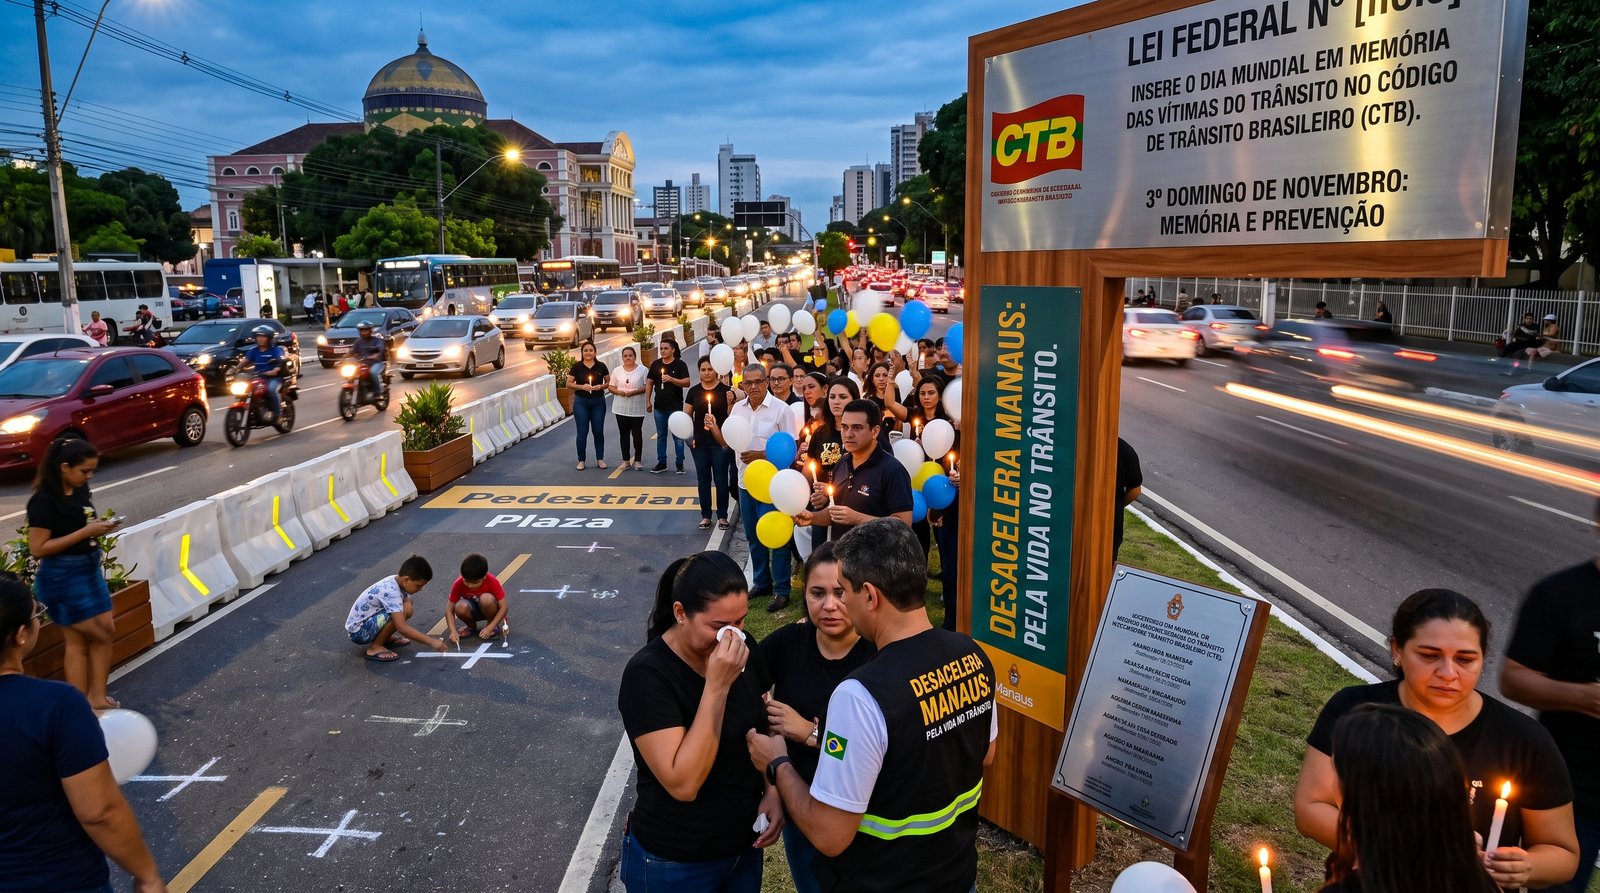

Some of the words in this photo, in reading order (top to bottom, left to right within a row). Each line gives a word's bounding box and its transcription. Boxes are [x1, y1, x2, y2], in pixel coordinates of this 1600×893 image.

[1128, 30, 1163, 66] LEI
[1172, 1, 1297, 57] FEDERAL
[1131, 77, 1181, 102] INSERE
[1186, 75, 1195, 93] O
[1201, 69, 1226, 91] DIA
[1232, 54, 1309, 85] MUNDIAL
[1315, 47, 1343, 71] EM
[1350, 28, 1450, 65] MEMÓRIA
[1127, 109, 1153, 129] DAS
[1158, 98, 1218, 124] VÍTIMAS
[1223, 94, 1245, 115] DO
[1251, 79, 1337, 110] TRÂNSITO
[1344, 74, 1371, 97] NO
[1378, 60, 1457, 92] CÓDIGO
[996, 116, 1077, 167] CTB
[1147, 133, 1164, 152] DE
[1169, 123, 1243, 149] TRÂNSITO
[1249, 107, 1354, 140] BRASILEIRO
[1361, 100, 1421, 131] (CTB).
[1146, 189, 1162, 208] 3º
[1167, 182, 1246, 207] DOMINGO
[1253, 179, 1276, 201] DE
[1282, 168, 1408, 199] NOVEMBRO:
[1160, 209, 1240, 235] MEMÓRIA
[1246, 211, 1257, 231] E
[1262, 200, 1384, 235] PREVENÇÃO
[995, 302, 1026, 441] MANAUS:
[1026, 344, 1058, 474] TRÂNSITO.
[458, 492, 700, 505] Pedestrian
[484, 514, 614, 528] Plaza
[1028, 482, 1053, 518] NO
[990, 449, 1021, 639] DESACELERA
[1026, 526, 1050, 581] VIDA
[1023, 590, 1048, 651] PELA
[910, 652, 984, 698] DESACELERA
[995, 682, 1033, 708] Manaus
[926, 725, 943, 741] PELA
[943, 718, 957, 733] VIDA
[956, 713, 966, 726] NO
